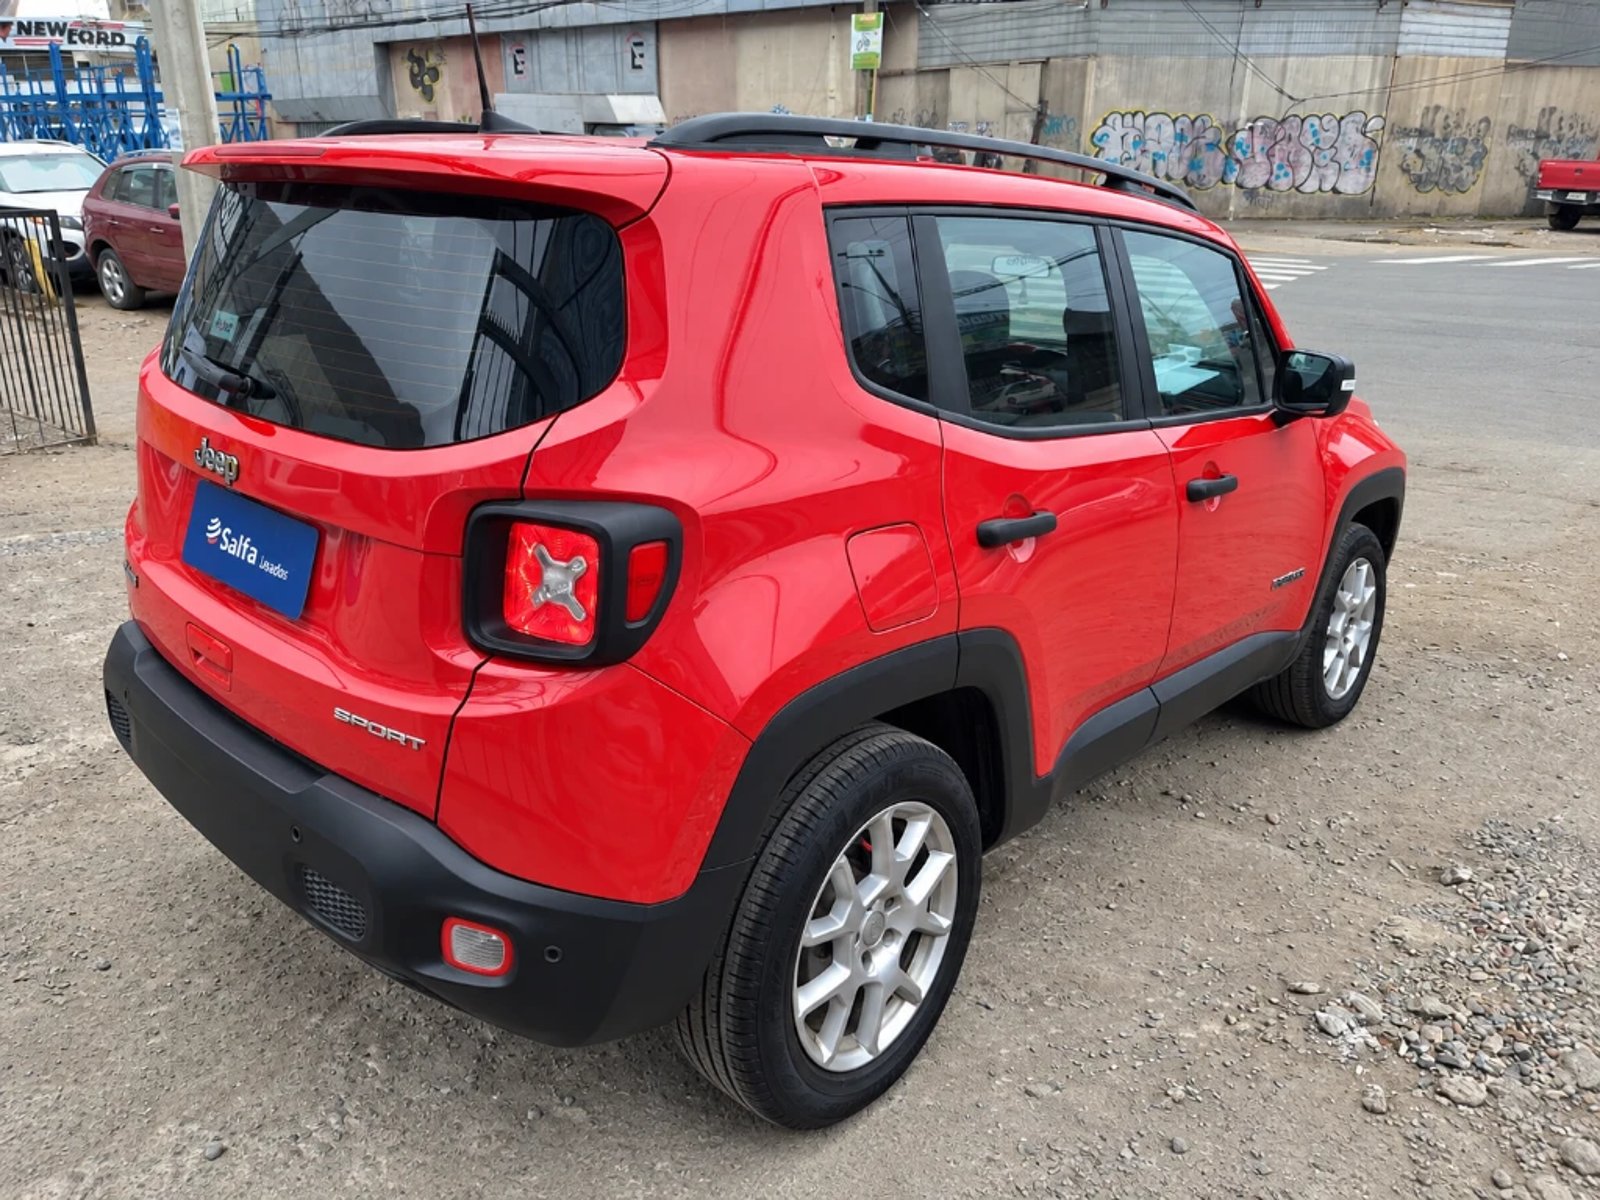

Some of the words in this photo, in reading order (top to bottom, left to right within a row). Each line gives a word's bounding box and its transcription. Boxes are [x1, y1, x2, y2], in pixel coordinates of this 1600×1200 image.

[16, 21, 68, 37] NEW
[194, 436, 239, 488] Jeep
[220, 527, 258, 565] Salfa
[334, 707, 427, 751] SPORT
